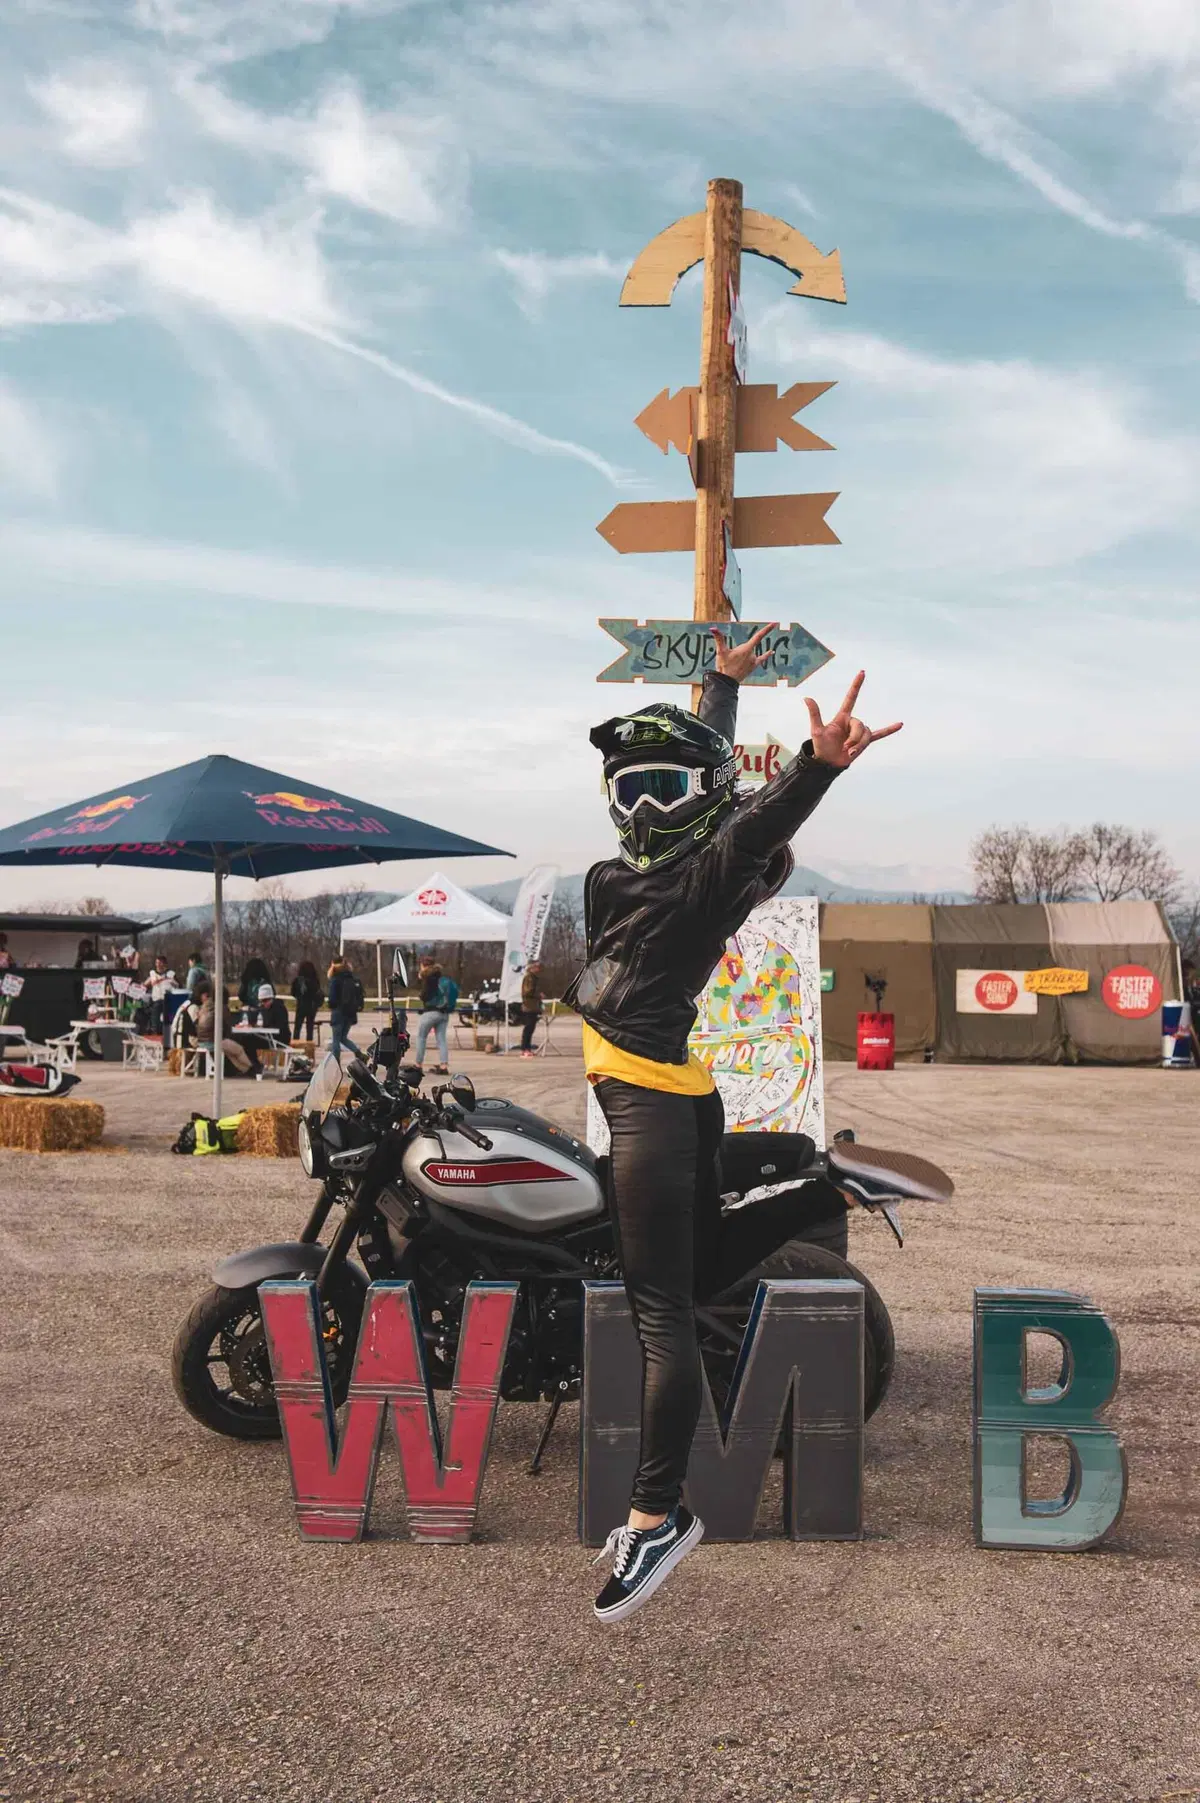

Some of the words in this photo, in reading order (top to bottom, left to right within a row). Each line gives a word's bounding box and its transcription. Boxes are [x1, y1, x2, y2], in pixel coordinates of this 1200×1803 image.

[981, 980, 1013, 993] FASTER
[1110, 976, 1154, 993] FASTER
[1118, 992, 1149, 1010] SONS
[437, 1168, 476, 1180] YAMAHA
